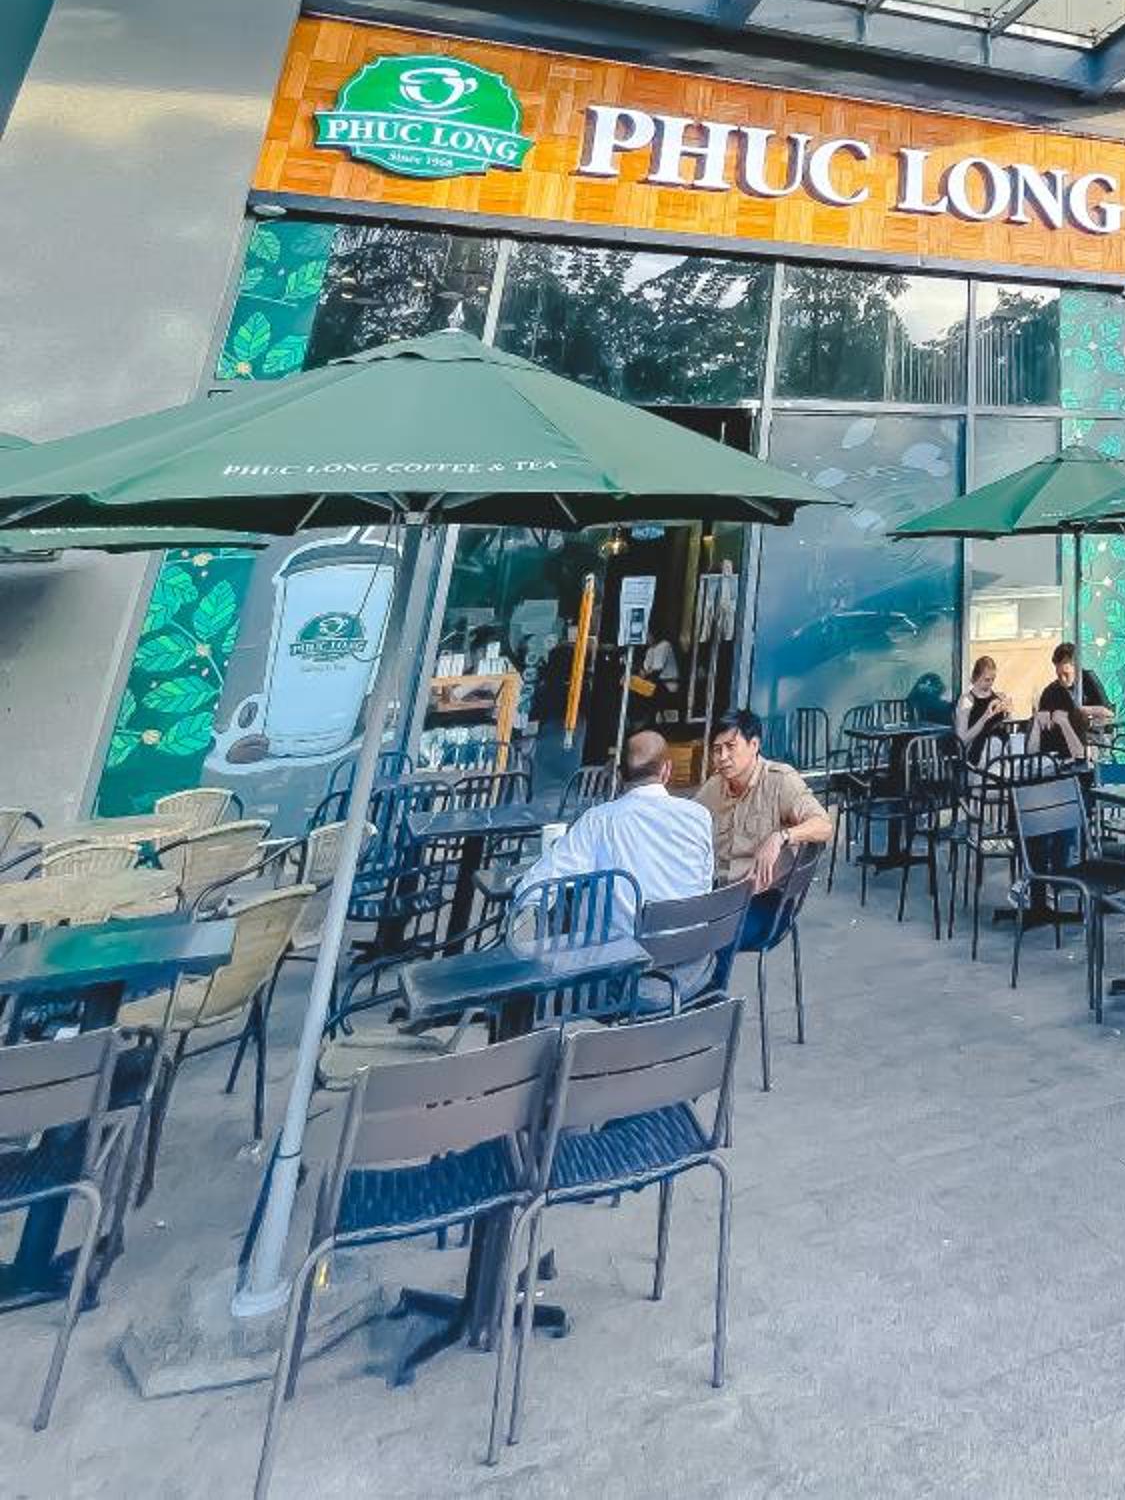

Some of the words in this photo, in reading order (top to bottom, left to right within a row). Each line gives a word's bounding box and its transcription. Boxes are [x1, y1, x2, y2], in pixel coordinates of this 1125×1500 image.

[326, 118, 424, 144] PHUC
[431, 126, 519, 162] LONG
[387, 151, 422, 165] Since
[425, 154, 455, 168] 1968
[576, 103, 876, 210] PHUC
[222, 463, 300, 476] PHUC
[303, 462, 380, 474] LONG
[384, 461, 483, 474] COFFEE
[487, 461, 506, 473] &
[512, 459, 561, 473] TEA
